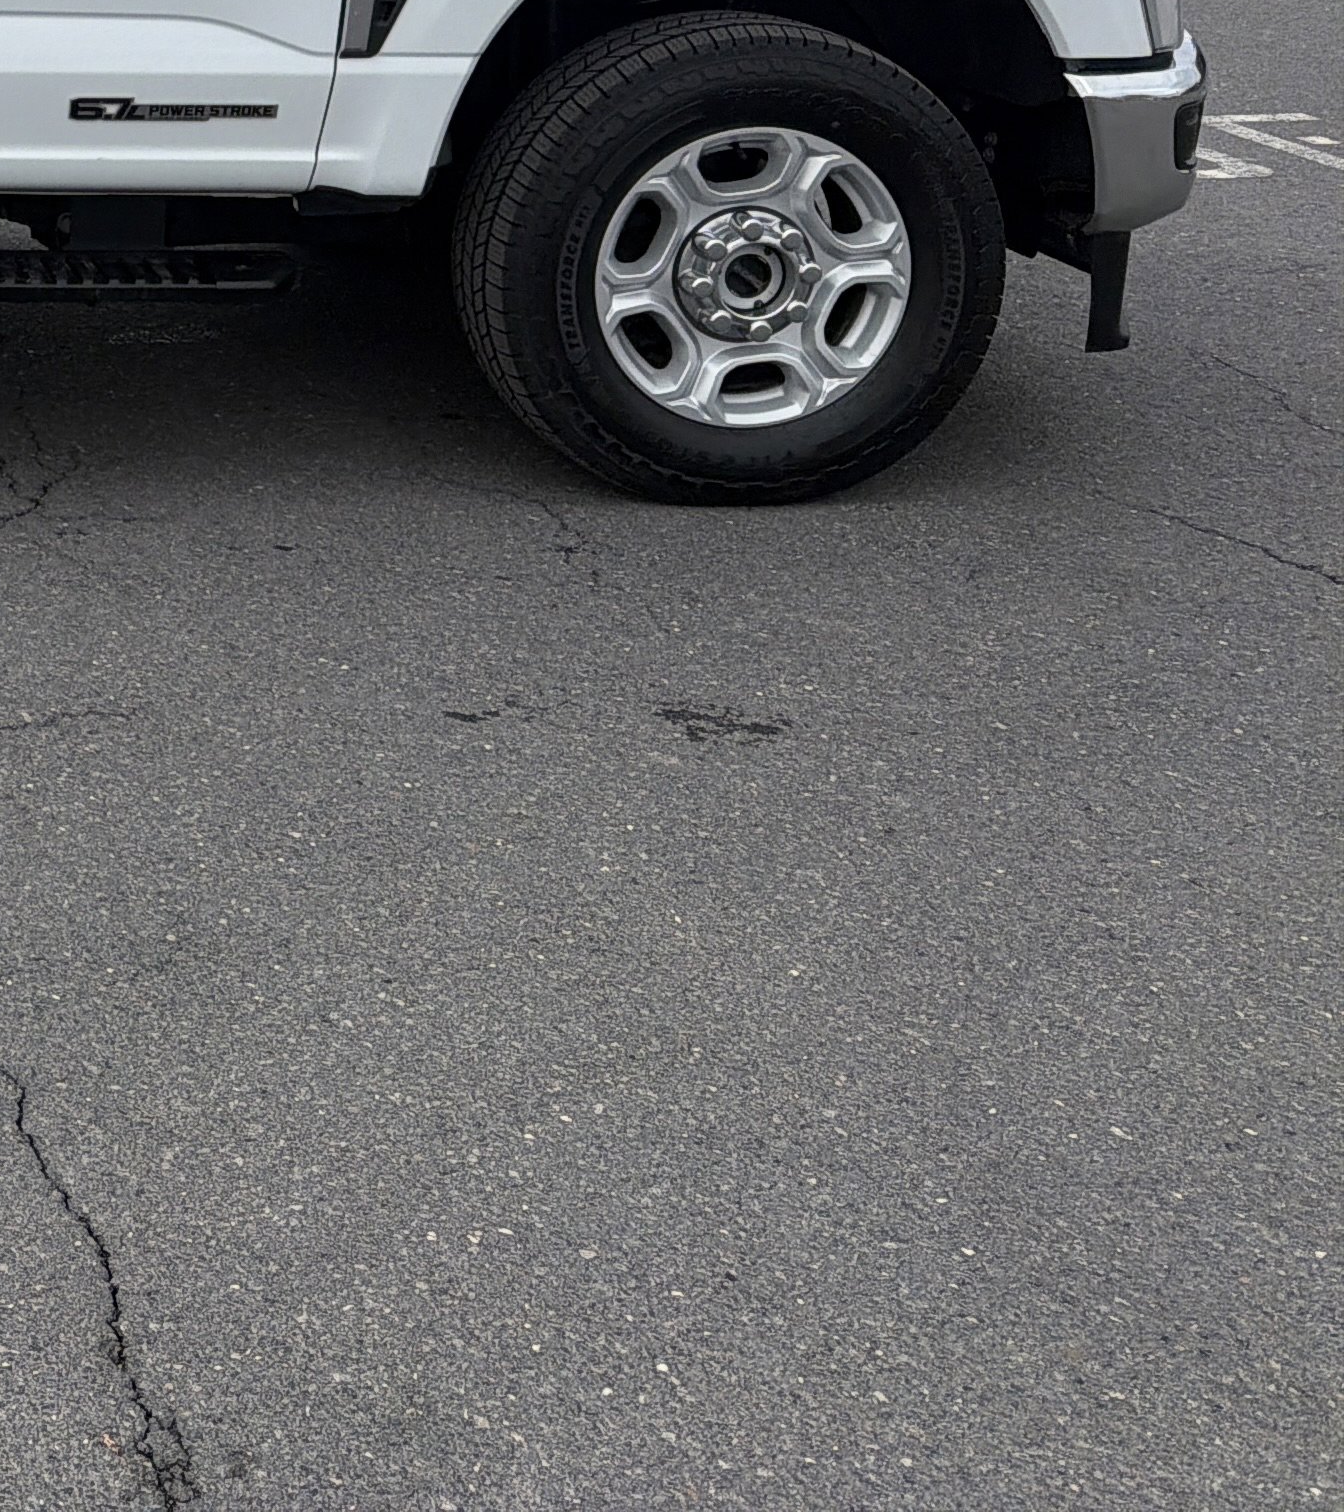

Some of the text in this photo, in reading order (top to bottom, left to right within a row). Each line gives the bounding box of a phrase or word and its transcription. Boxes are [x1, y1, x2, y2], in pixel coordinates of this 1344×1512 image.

[149, 104, 205, 118] POWER
[210, 104, 273, 118] STROKE
[559, 233, 582, 350] TRANSFORCE
